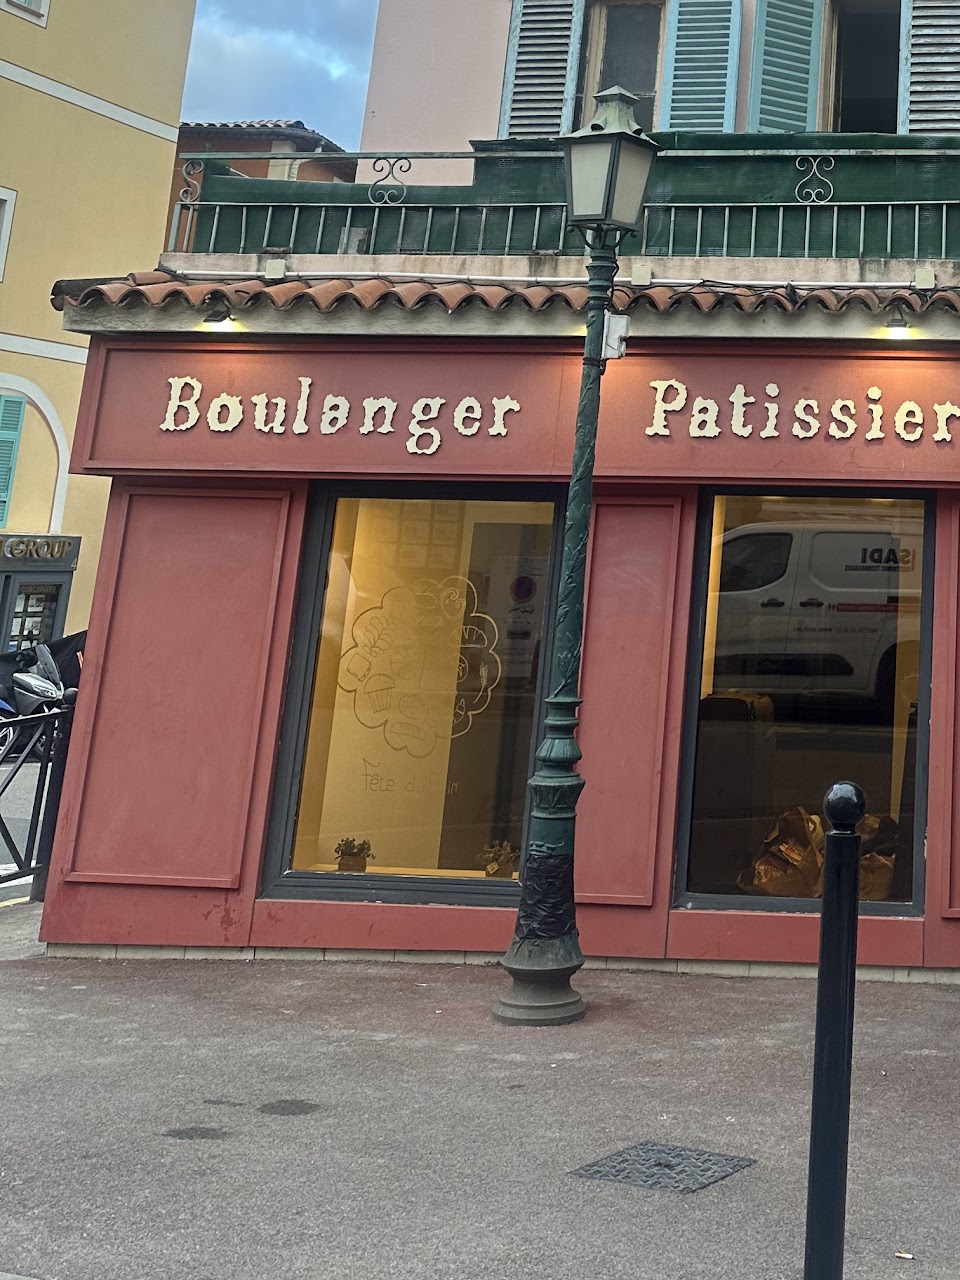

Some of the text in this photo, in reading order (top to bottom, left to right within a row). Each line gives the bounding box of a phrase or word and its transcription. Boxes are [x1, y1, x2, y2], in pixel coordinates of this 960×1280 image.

[159, 375, 521, 455] Boulanger
[4, 538, 72, 558] GROUP
[361, 757, 396, 792] Fête
[428, 771, 460, 795] Pin
